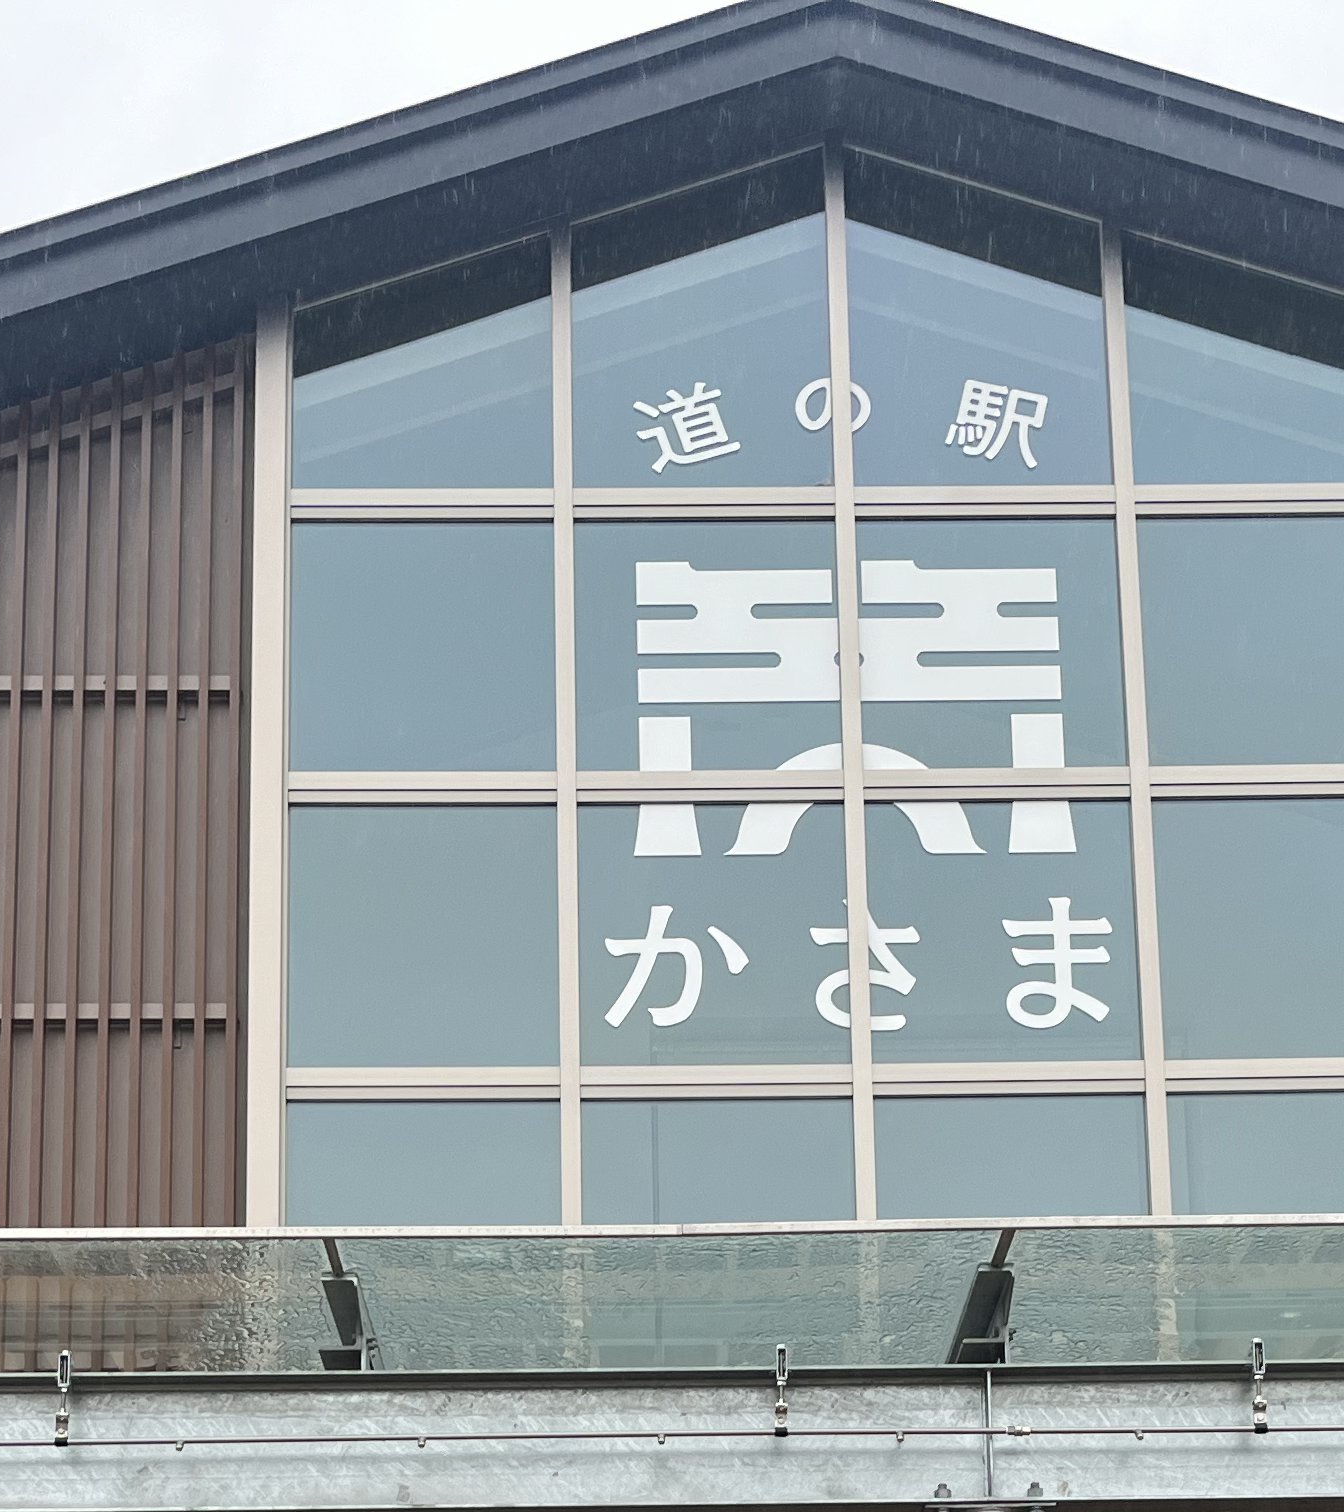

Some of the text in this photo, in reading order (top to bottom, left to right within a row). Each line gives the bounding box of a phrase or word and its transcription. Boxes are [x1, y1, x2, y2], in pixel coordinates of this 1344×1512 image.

[633, 377, 1048, 472] 道の駅
[604, 897, 1113, 1030] かさま
